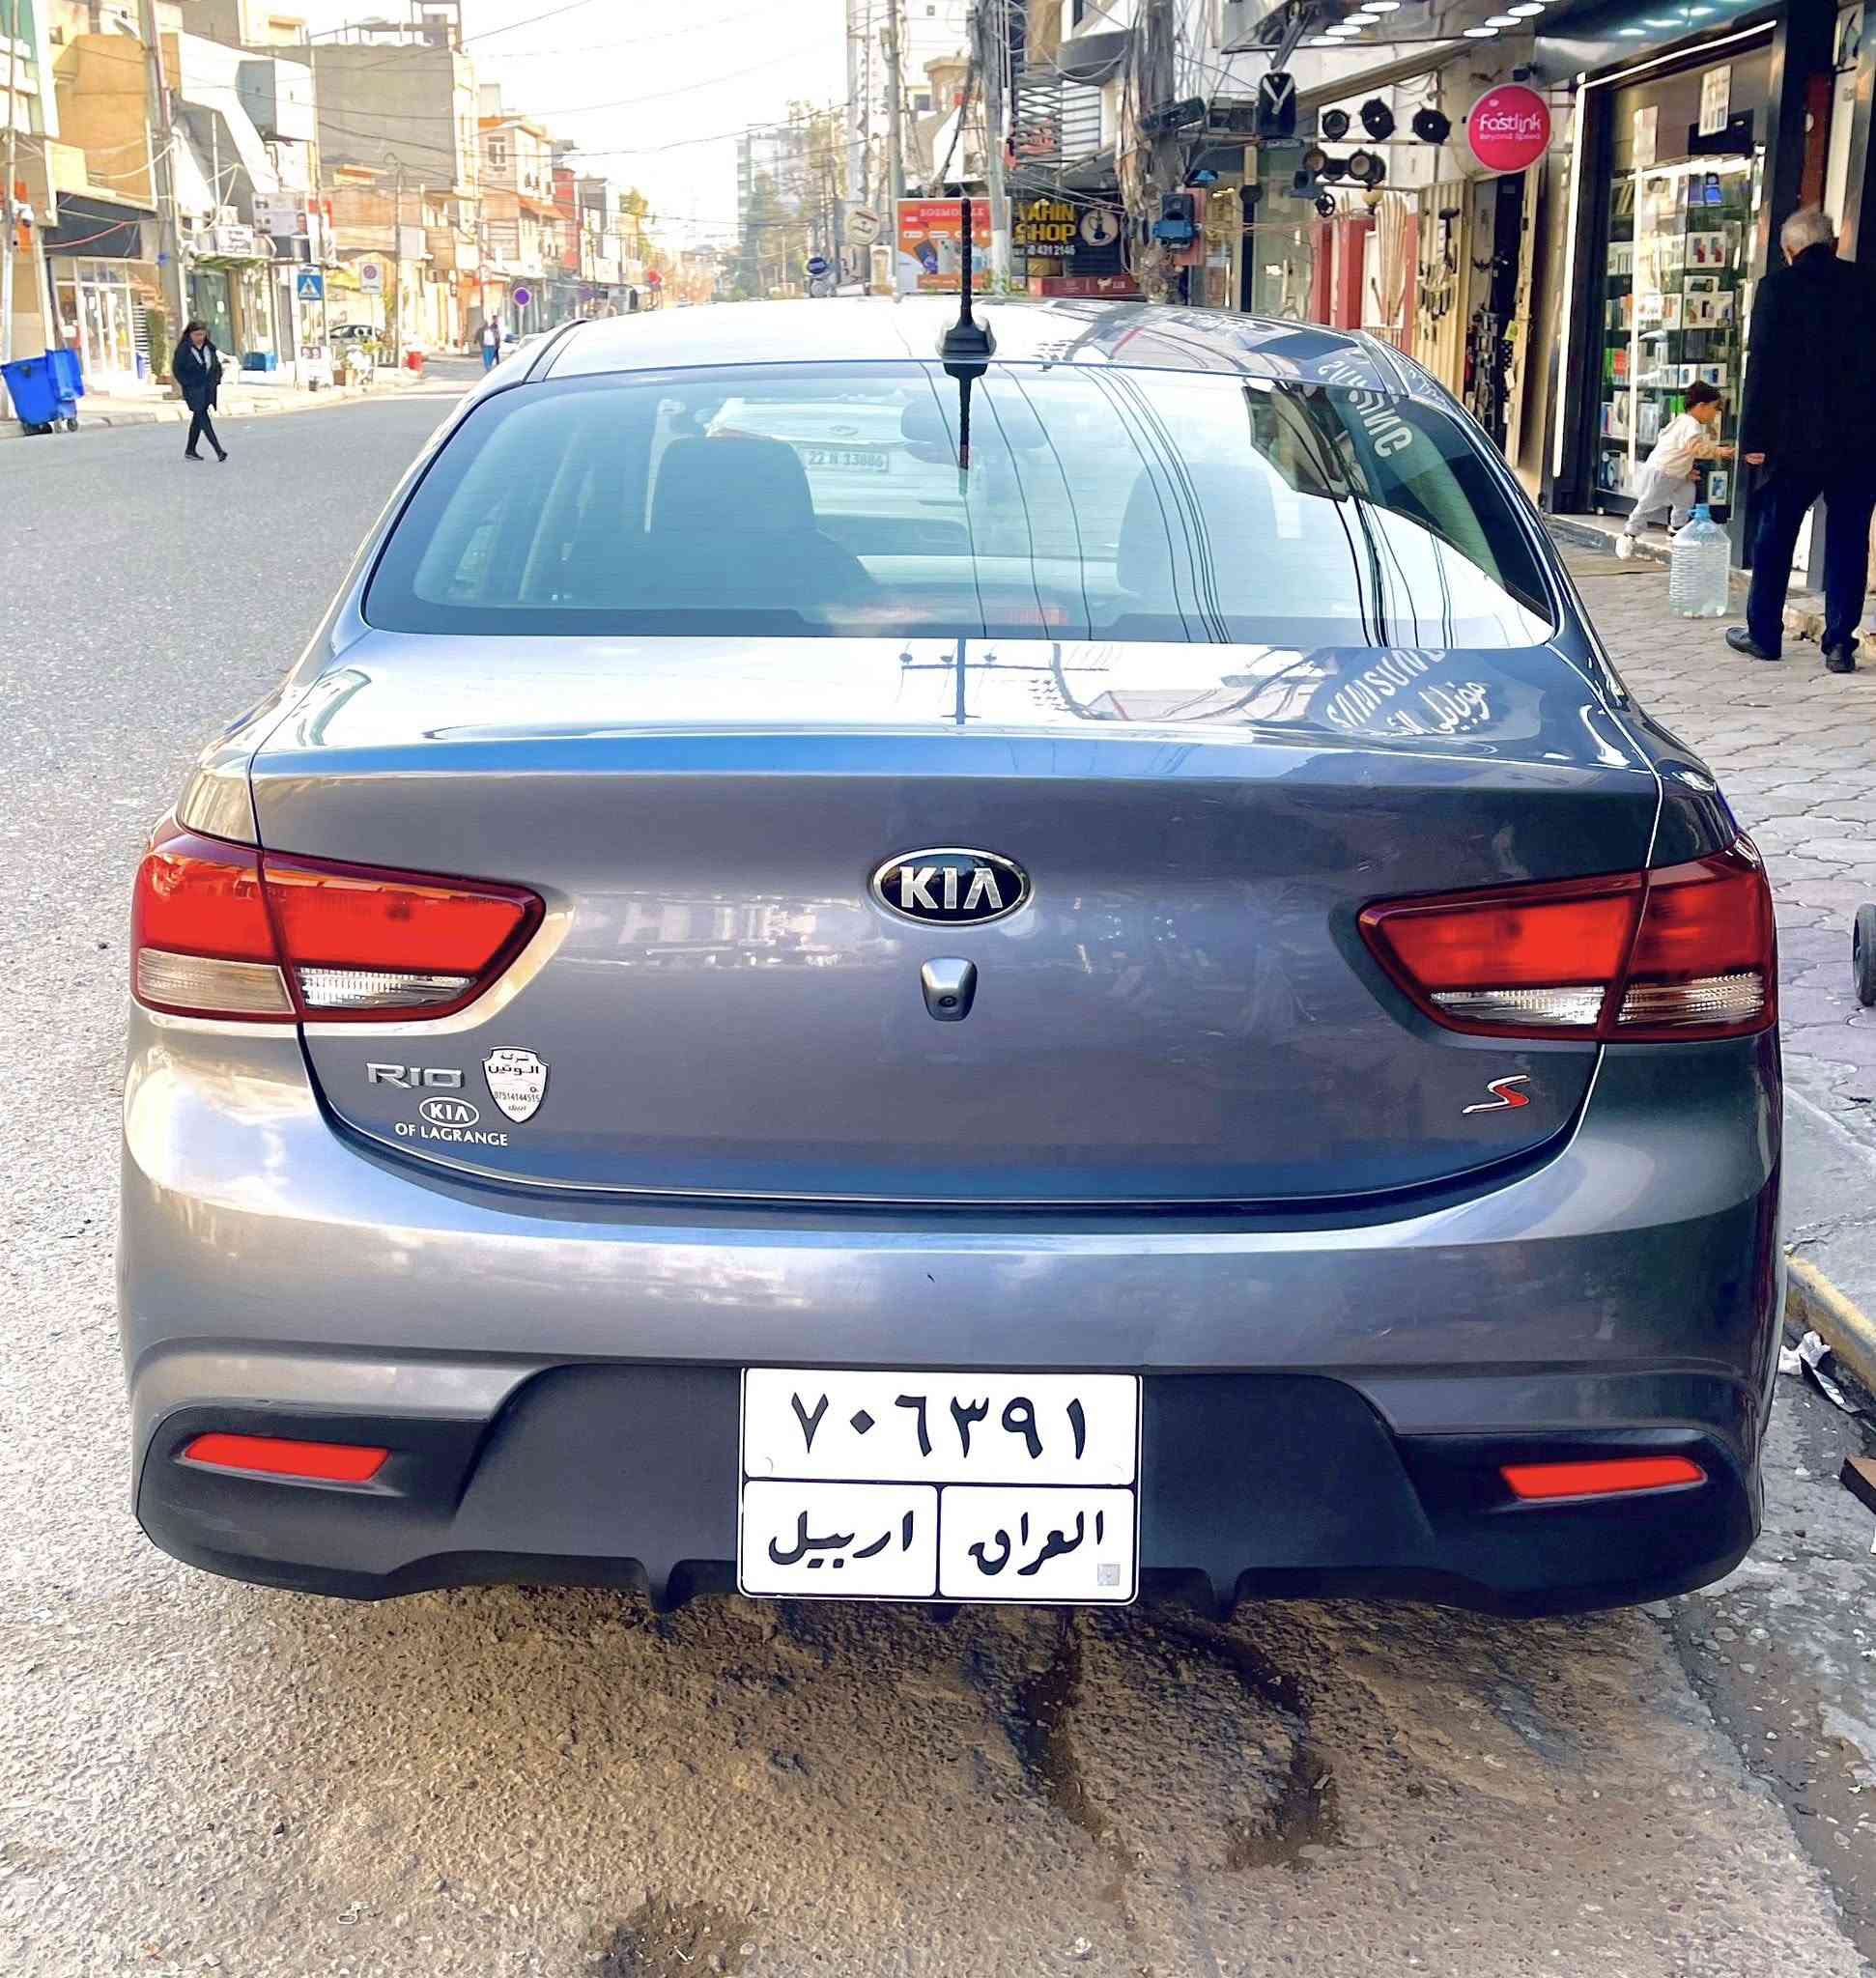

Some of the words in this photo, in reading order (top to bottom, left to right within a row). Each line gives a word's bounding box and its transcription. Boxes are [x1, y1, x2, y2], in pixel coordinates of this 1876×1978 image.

[1013, 223, 1077, 242] SHOP
[898, 865, 1004, 910] KIA
[429, 1102, 469, 1122] KIA
[1462, 1074, 1531, 1114] S
[394, 1122, 417, 1137] OF
[420, 1126, 508, 1147] LAGRANGE
[790, 1391, 1087, 1460] ٧٠٦٣٩١
[768, 1510, 914, 1569] اربيل
[968, 1510, 1104, 1576] العراق
